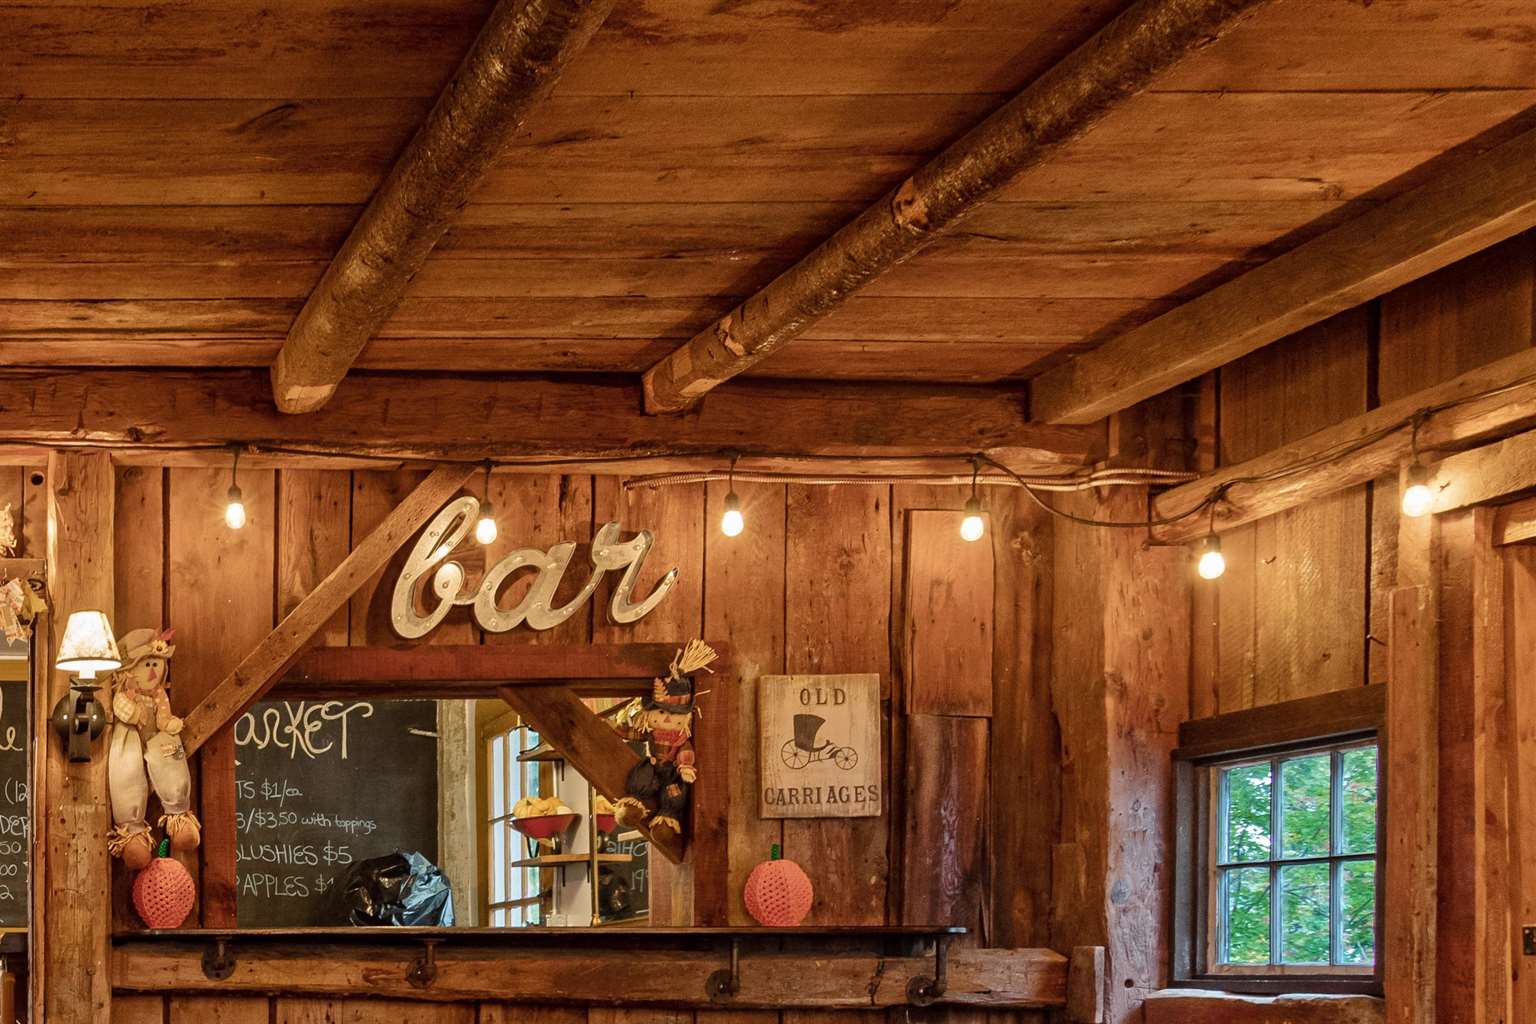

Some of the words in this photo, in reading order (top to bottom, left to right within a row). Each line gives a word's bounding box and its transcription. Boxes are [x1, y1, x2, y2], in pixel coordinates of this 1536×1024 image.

[391, 496, 679, 640] bar
[799, 688, 846, 706] OLD
[764, 784, 879, 806] CARRIAGES
[301, 812, 332, 828] with
[335, 814, 377, 835] toppings
[323, 840, 353, 866] $5
[243, 873, 310, 899] APPLES
